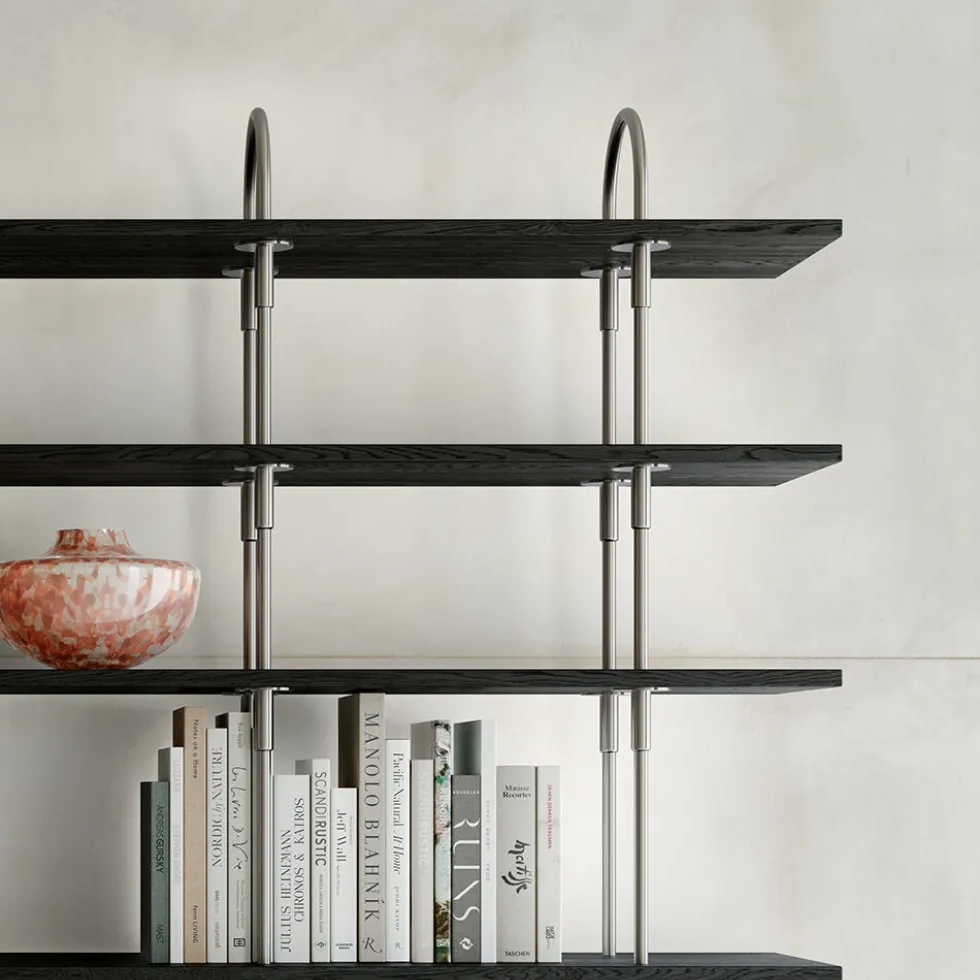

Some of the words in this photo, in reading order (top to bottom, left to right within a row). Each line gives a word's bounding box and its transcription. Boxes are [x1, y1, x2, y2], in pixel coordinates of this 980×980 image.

[192, 742, 198, 751] on
[364, 712, 380, 807] MANOLO
[393, 752, 404, 787] Pacific
[211, 748, 222, 800] NATURE
[294, 798, 305, 845] KAIROS
[336, 809, 346, 832] Jeff
[393, 789, 404, 826] Natural
[211, 818, 222, 867] NORDIC
[281, 829, 292, 899] HEINEMANN
[336, 836, 346, 861] Wall
[393, 846, 404, 875] Home
[364, 820, 384, 922] BLAHNÍK
[453, 817, 480, 921] RUINS
[294, 867, 305, 923] CHRONOS
[281, 906, 292, 952] JULIUS
